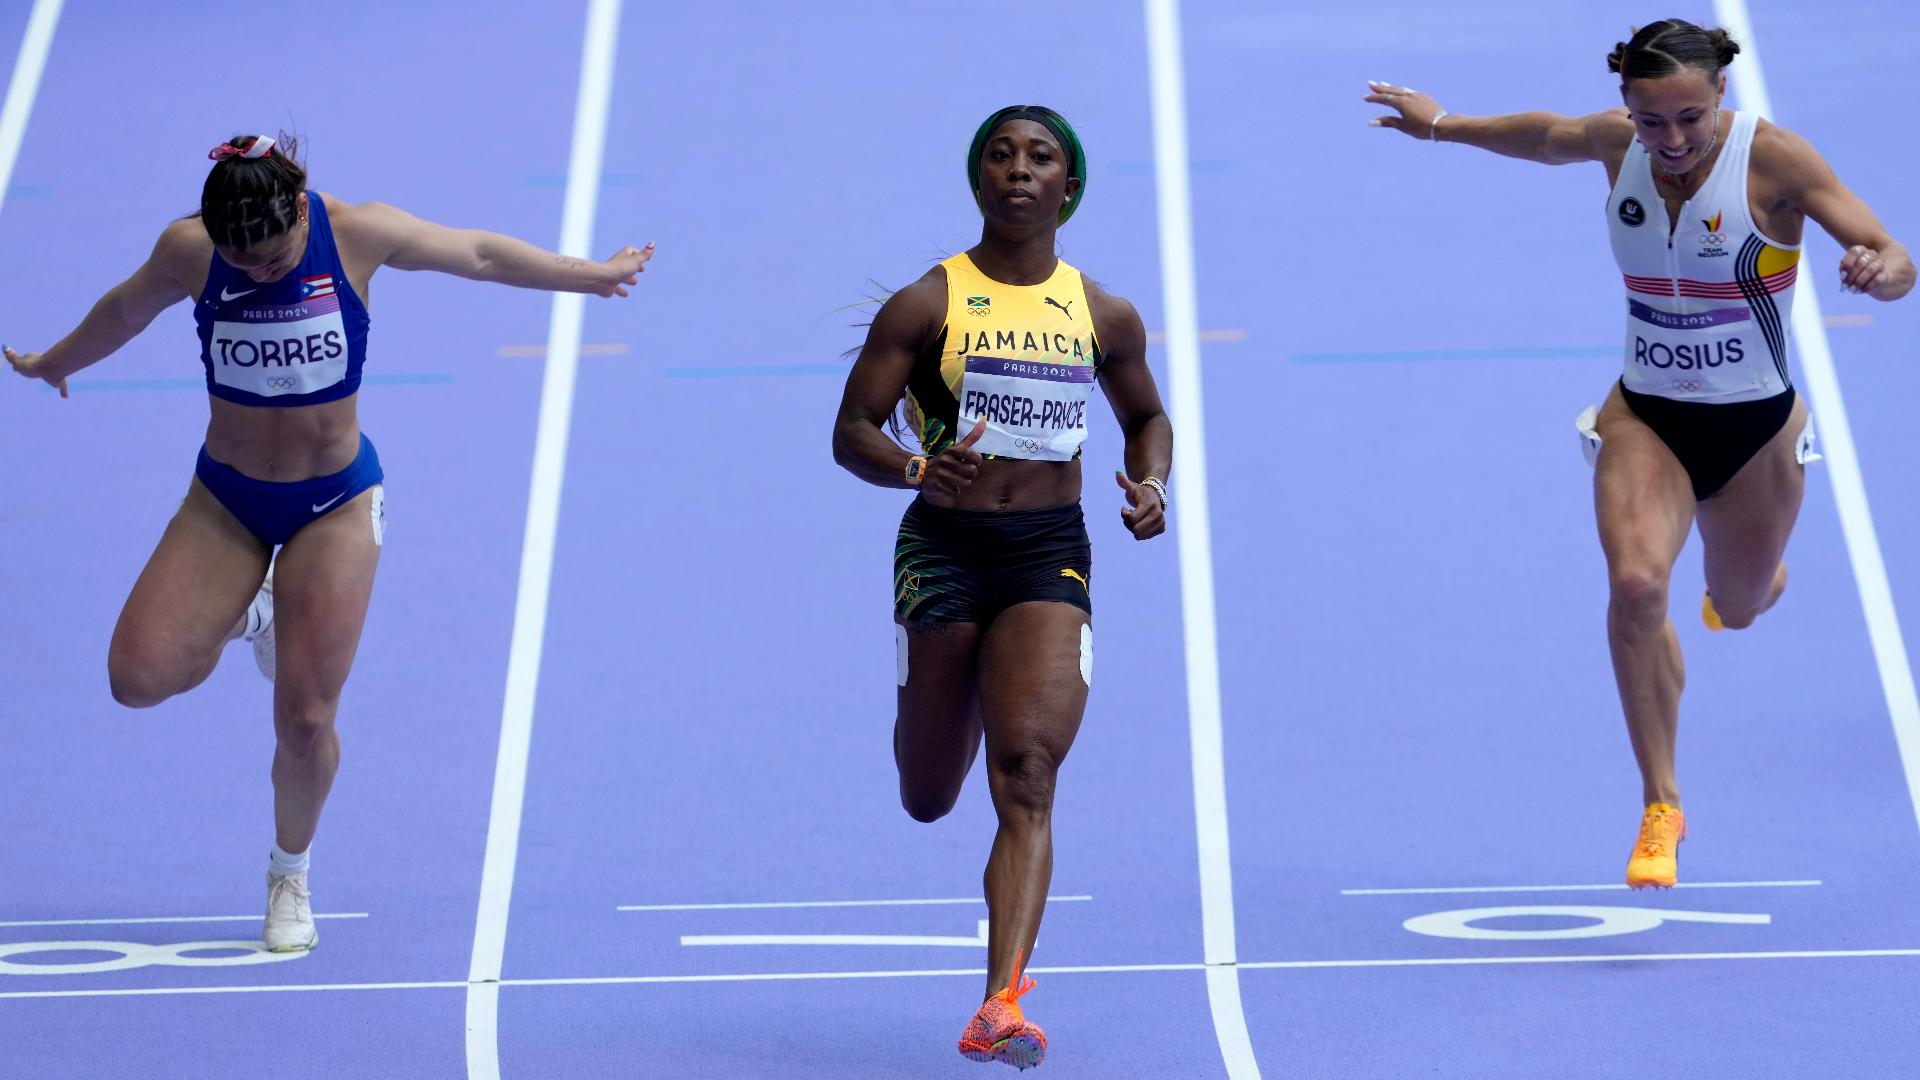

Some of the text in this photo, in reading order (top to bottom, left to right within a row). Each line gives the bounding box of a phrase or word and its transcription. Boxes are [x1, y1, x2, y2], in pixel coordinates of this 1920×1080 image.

[243, 307, 309, 318] PARIS 2024
[1651, 311, 1713, 325] PARIS 2024
[216, 330, 343, 368] TORRES
[957, 330, 1085, 362] JAMAICA
[1635, 336, 1744, 370] ROSIUS
[1003, 362, 1073, 378] PARIS 2024
[965, 391, 1085, 429] FRASER-PRYCE
[0, 940, 310, 974] 8
